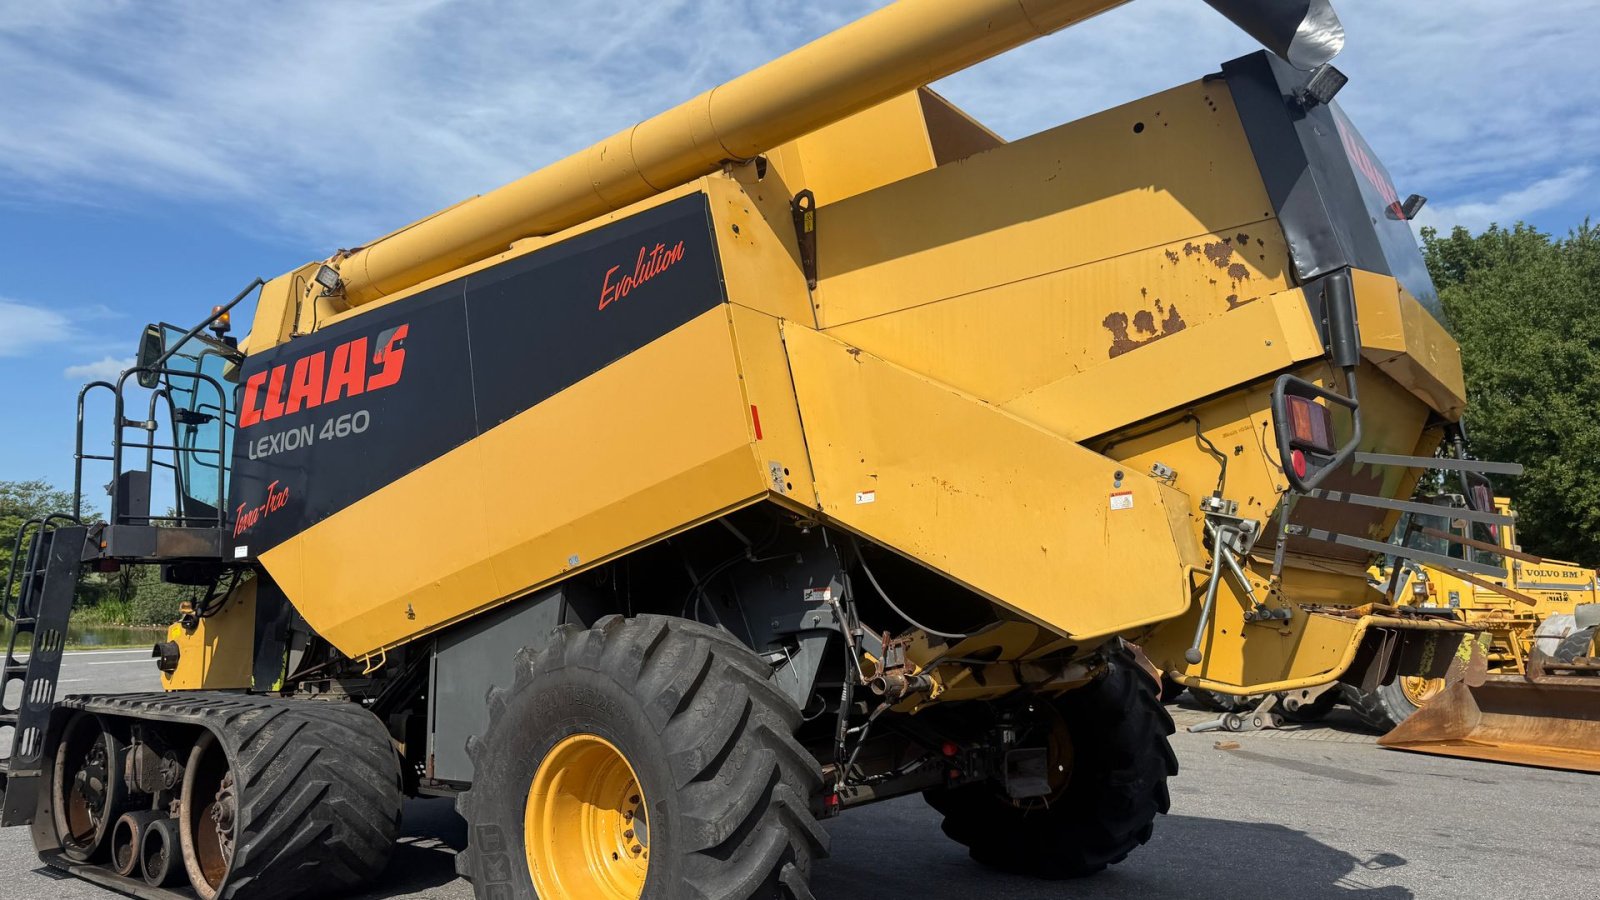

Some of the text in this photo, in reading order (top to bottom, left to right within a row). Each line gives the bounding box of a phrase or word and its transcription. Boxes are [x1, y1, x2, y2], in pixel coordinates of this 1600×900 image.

[599, 240, 685, 311] Evolution
[239, 323, 409, 429] CLAAS
[248, 409, 370, 460] LEXION 460
[232, 479, 290, 539] Terra-Trac
[1526, 569, 1559, 577] VOLVO
[1562, 570, 1578, 578] BM
